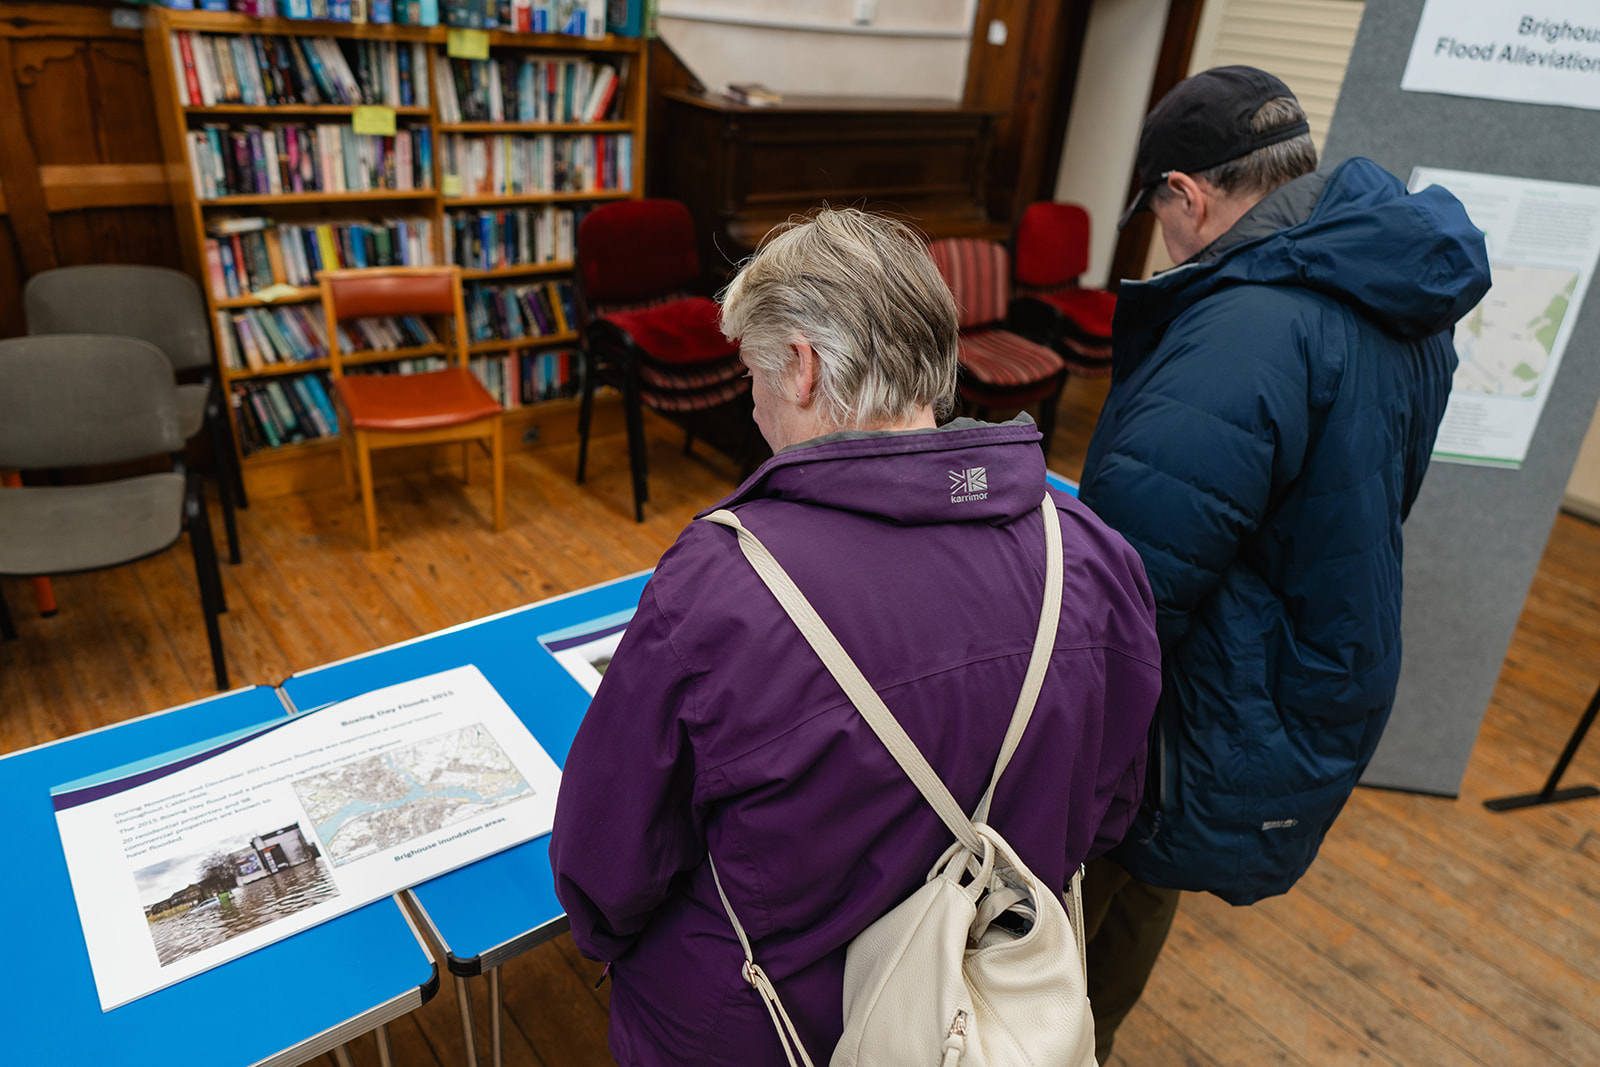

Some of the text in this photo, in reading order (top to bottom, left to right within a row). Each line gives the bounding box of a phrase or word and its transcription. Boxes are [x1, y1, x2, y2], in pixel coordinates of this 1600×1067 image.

[1435, 36, 1600, 73] Flood Alleviation
[951, 492, 988, 503] karrimor
[341, 690, 454, 727] Boxing Day Floods 2015
[114, 806, 142, 818] During
[115, 806, 163, 824] throughout
[123, 828, 174, 852] commercial
[174, 817, 218, 835] properties
[233, 800, 261, 813] known
[135, 821, 179, 840] residential
[181, 808, 222, 825] properties
[225, 801, 239, 810] and
[138, 818, 158, 829] 2015
[160, 809, 188, 820] Boxing
[206, 795, 227, 805] flood
[126, 849, 147, 859] have
[394, 843, 437, 862] Brighouse
[438, 826, 483, 845] inundation
